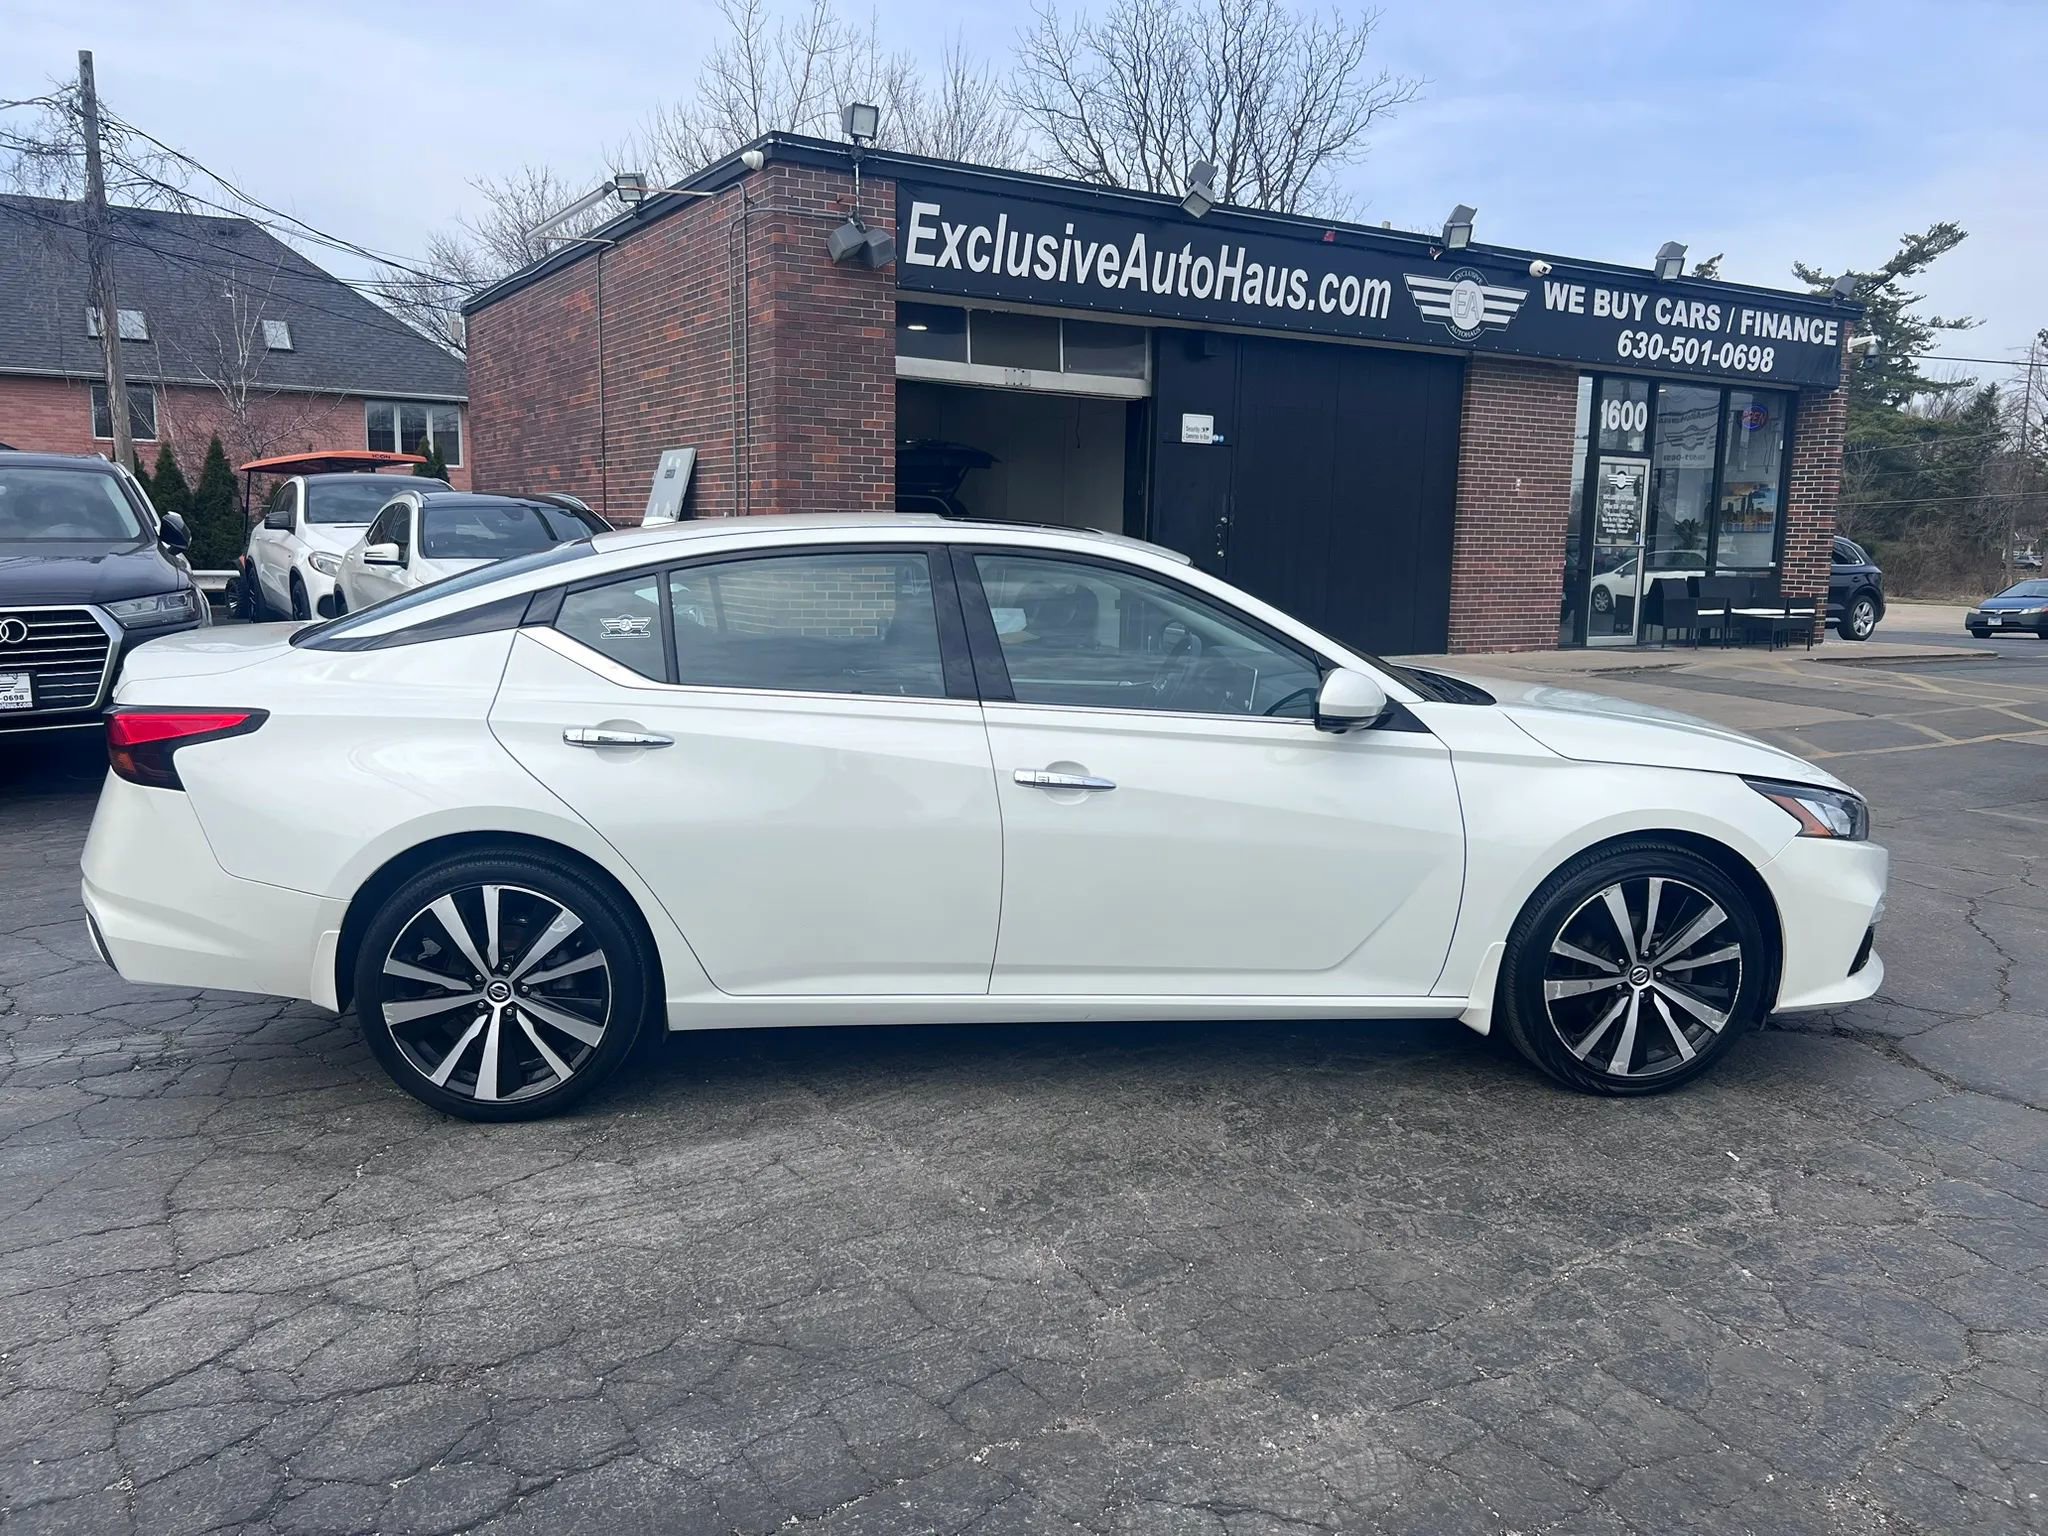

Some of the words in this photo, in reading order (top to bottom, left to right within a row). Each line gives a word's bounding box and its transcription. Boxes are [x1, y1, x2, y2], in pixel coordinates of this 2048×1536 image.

[904, 200, 1392, 320] ExclusiveAutoHaus.com
[1454, 270, 1483, 285] EXCLUSIVE
[1454, 289, 1480, 321] EA
[1543, 281, 1586, 314] WE
[1593, 288, 1649, 321] BUY
[1655, 297, 1721, 332] CARS
[1725, 306, 1736, 334] /
[1740, 309, 1839, 346] FINANCE
[1450, 325, 1481, 338] AUTOHAUS
[1617, 329, 1775, 373] 630-501-0698
[1600, 399, 1648, 432] 1600
